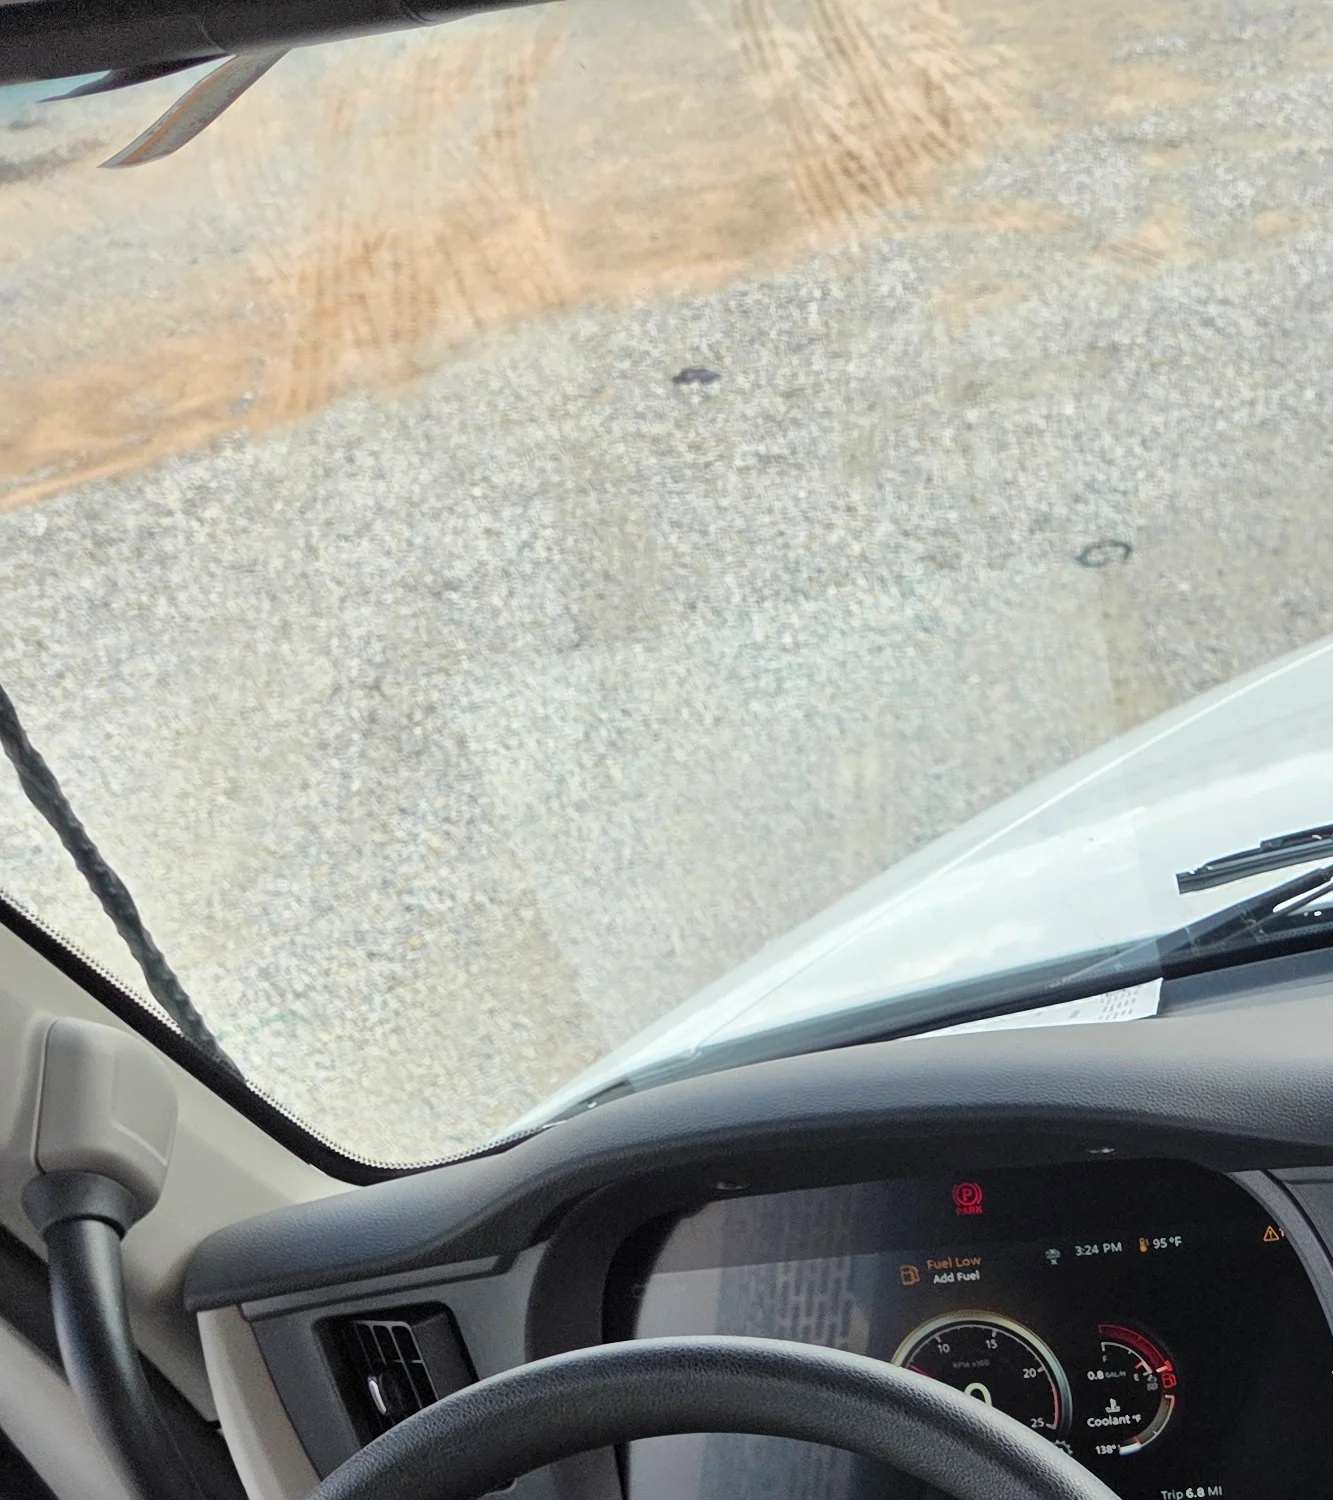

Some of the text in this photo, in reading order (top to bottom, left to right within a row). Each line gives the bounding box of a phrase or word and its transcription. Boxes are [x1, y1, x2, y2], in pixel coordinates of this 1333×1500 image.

[956, 1205, 983, 1217] PARK
[1075, 1241, 1123, 1257] 3:24 PM
[926, 1255, 982, 1271] Fuel Low
[933, 1270, 981, 1285] Add Fuel
[937, 1343, 950, 1354] 10
[985, 1338, 998, 1350] 15
[1022, 1367, 1037, 1379] 20
[1087, 1370, 1105, 1381] 0.8
[1031, 1417, 1045, 1429] 25
[1087, 1413, 1130, 1429] Coolant
[1185, 1486, 1206, 1499] 6.8
[1208, 1485, 1224, 1498] MI
